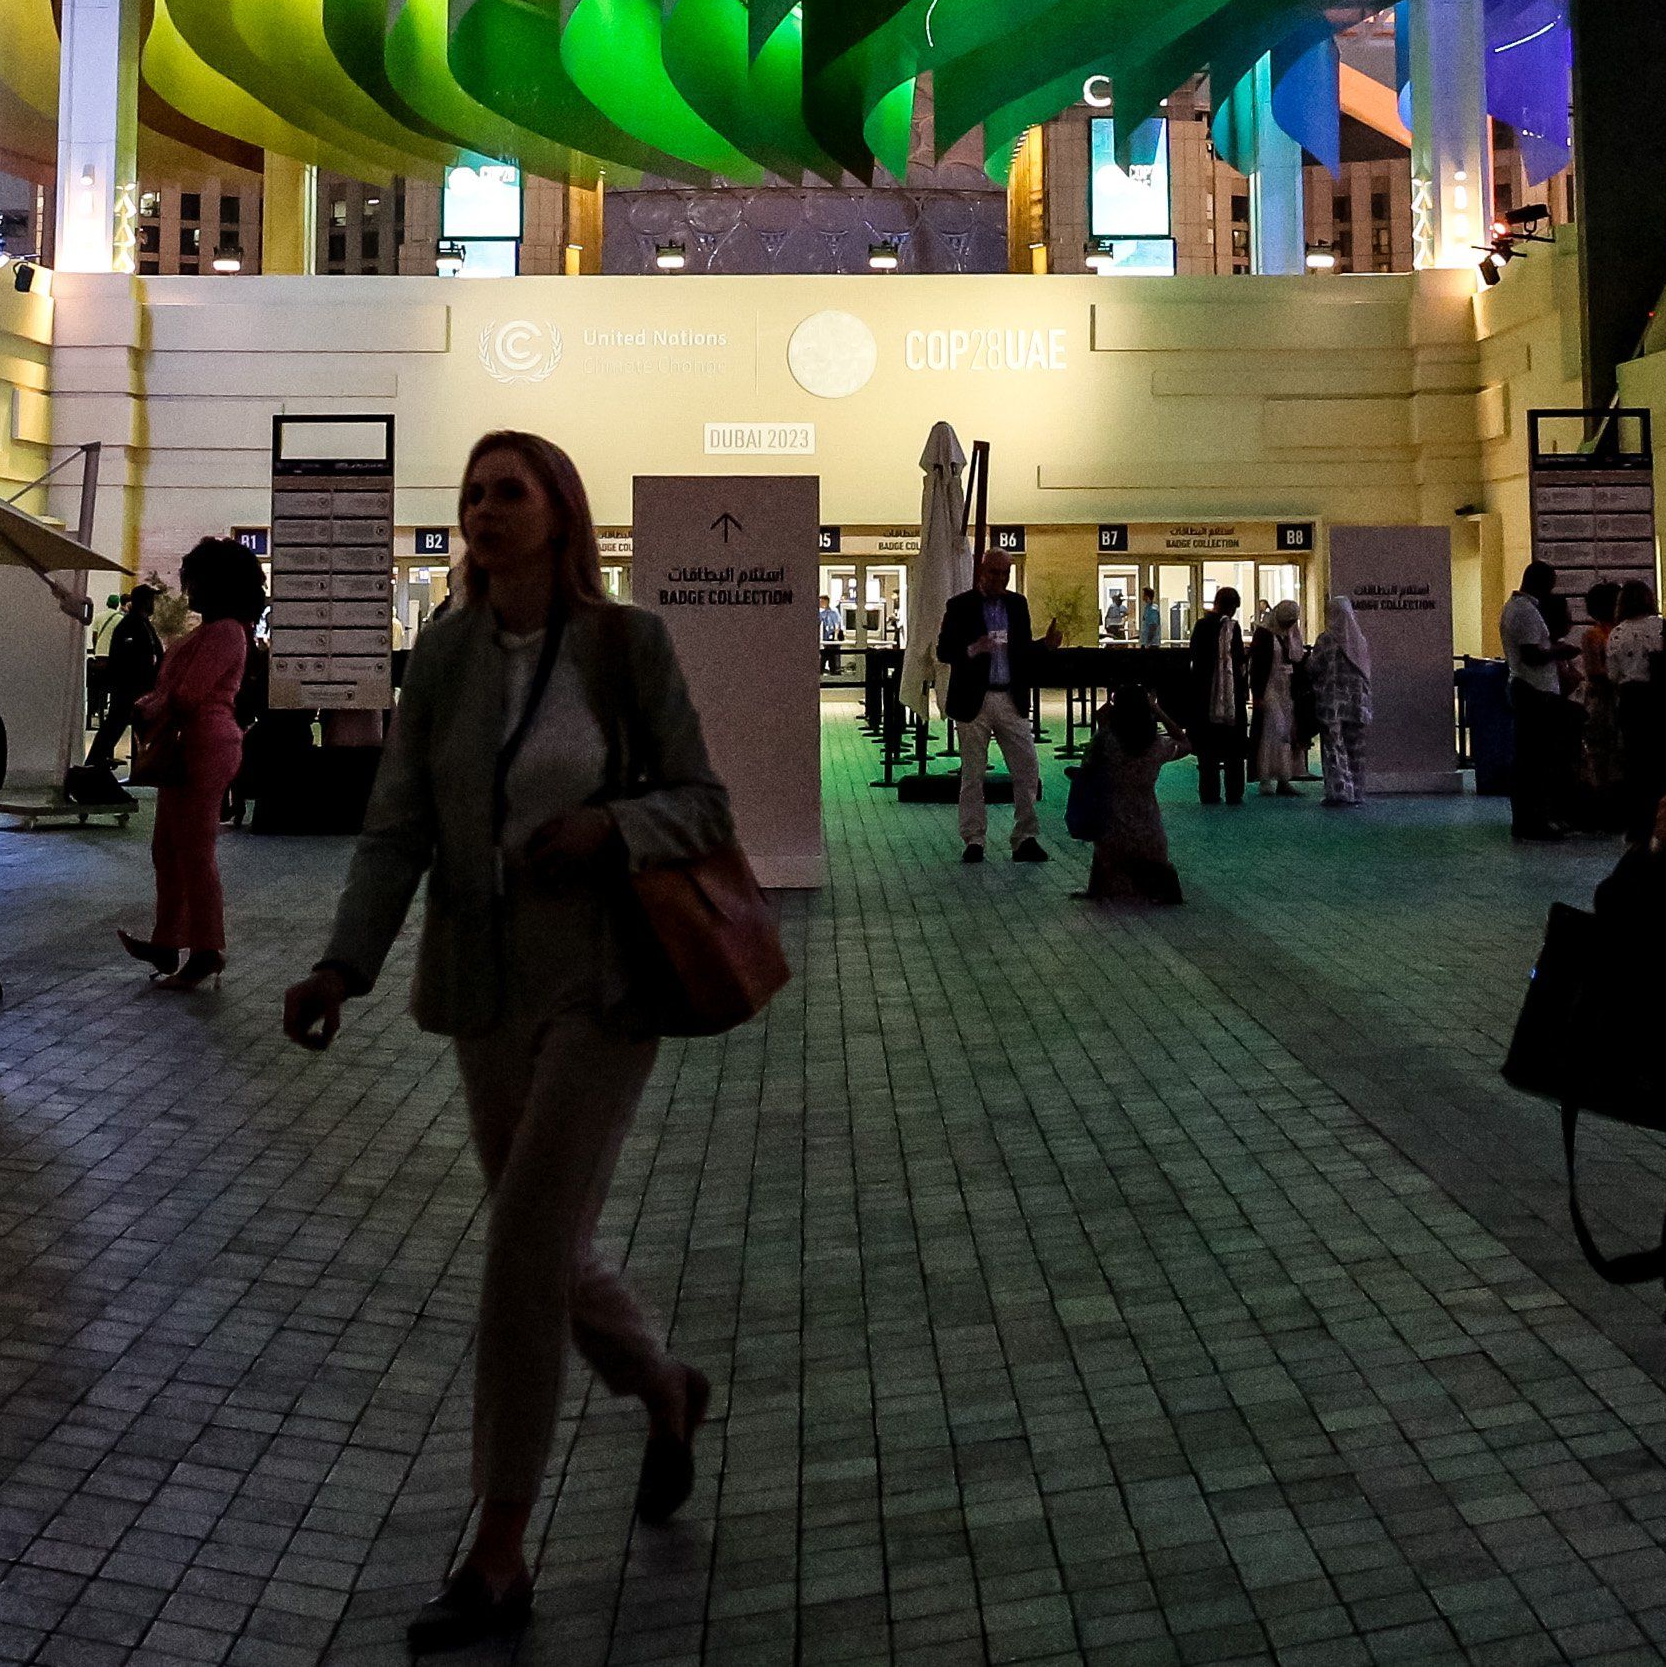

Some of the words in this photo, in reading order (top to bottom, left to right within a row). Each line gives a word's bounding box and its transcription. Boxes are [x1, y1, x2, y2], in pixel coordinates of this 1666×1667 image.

[583, 329, 646, 346] United
[653, 329, 727, 346] Nations
[904, 328, 1067, 371] COP28UAE
[583, 357, 653, 375] Climate
[657, 357, 725, 376] Change
[709, 428, 762, 448] DUBAI
[767, 428, 809, 448] 2023
[241, 534, 257, 549] B1
[425, 533, 443, 548] B2
[999, 532, 1016, 547] B6
[1101, 530, 1118, 546] B7
[1166, 539, 1191, 549] BADGE
[1193, 539, 1240, 549] COLLECTION
[1286, 530, 1304, 544] B8
[878, 541, 904, 551] BADGE
[659, 590, 705, 605] BADGE
[707, 590, 793, 605] COLLECTION
[1380, 599, 1435, 610] COLLECTION
